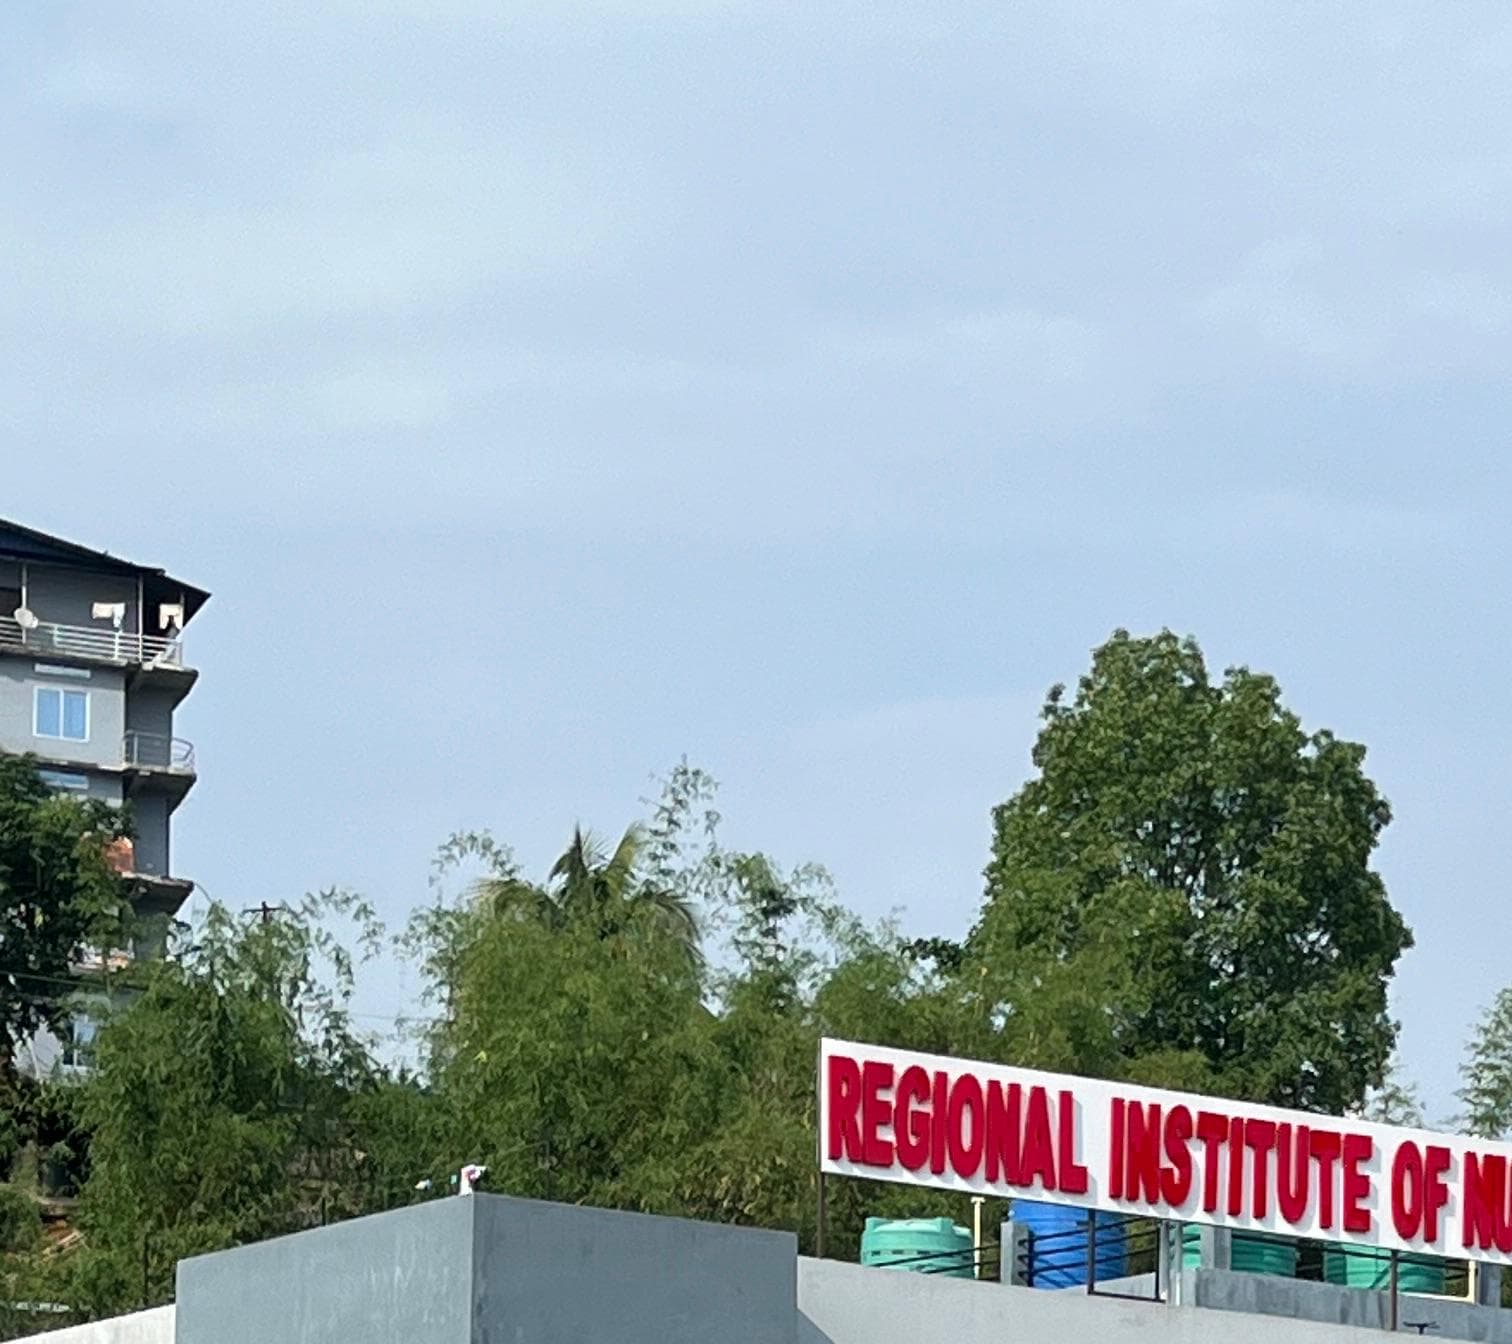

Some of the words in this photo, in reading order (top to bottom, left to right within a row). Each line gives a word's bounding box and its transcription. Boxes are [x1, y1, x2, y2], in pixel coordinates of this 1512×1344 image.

[828, 1055, 1088, 1194] REGIONAL
[1109, 1097, 1373, 1233] INSTITUTE
[1391, 1140, 1451, 1243] OF
